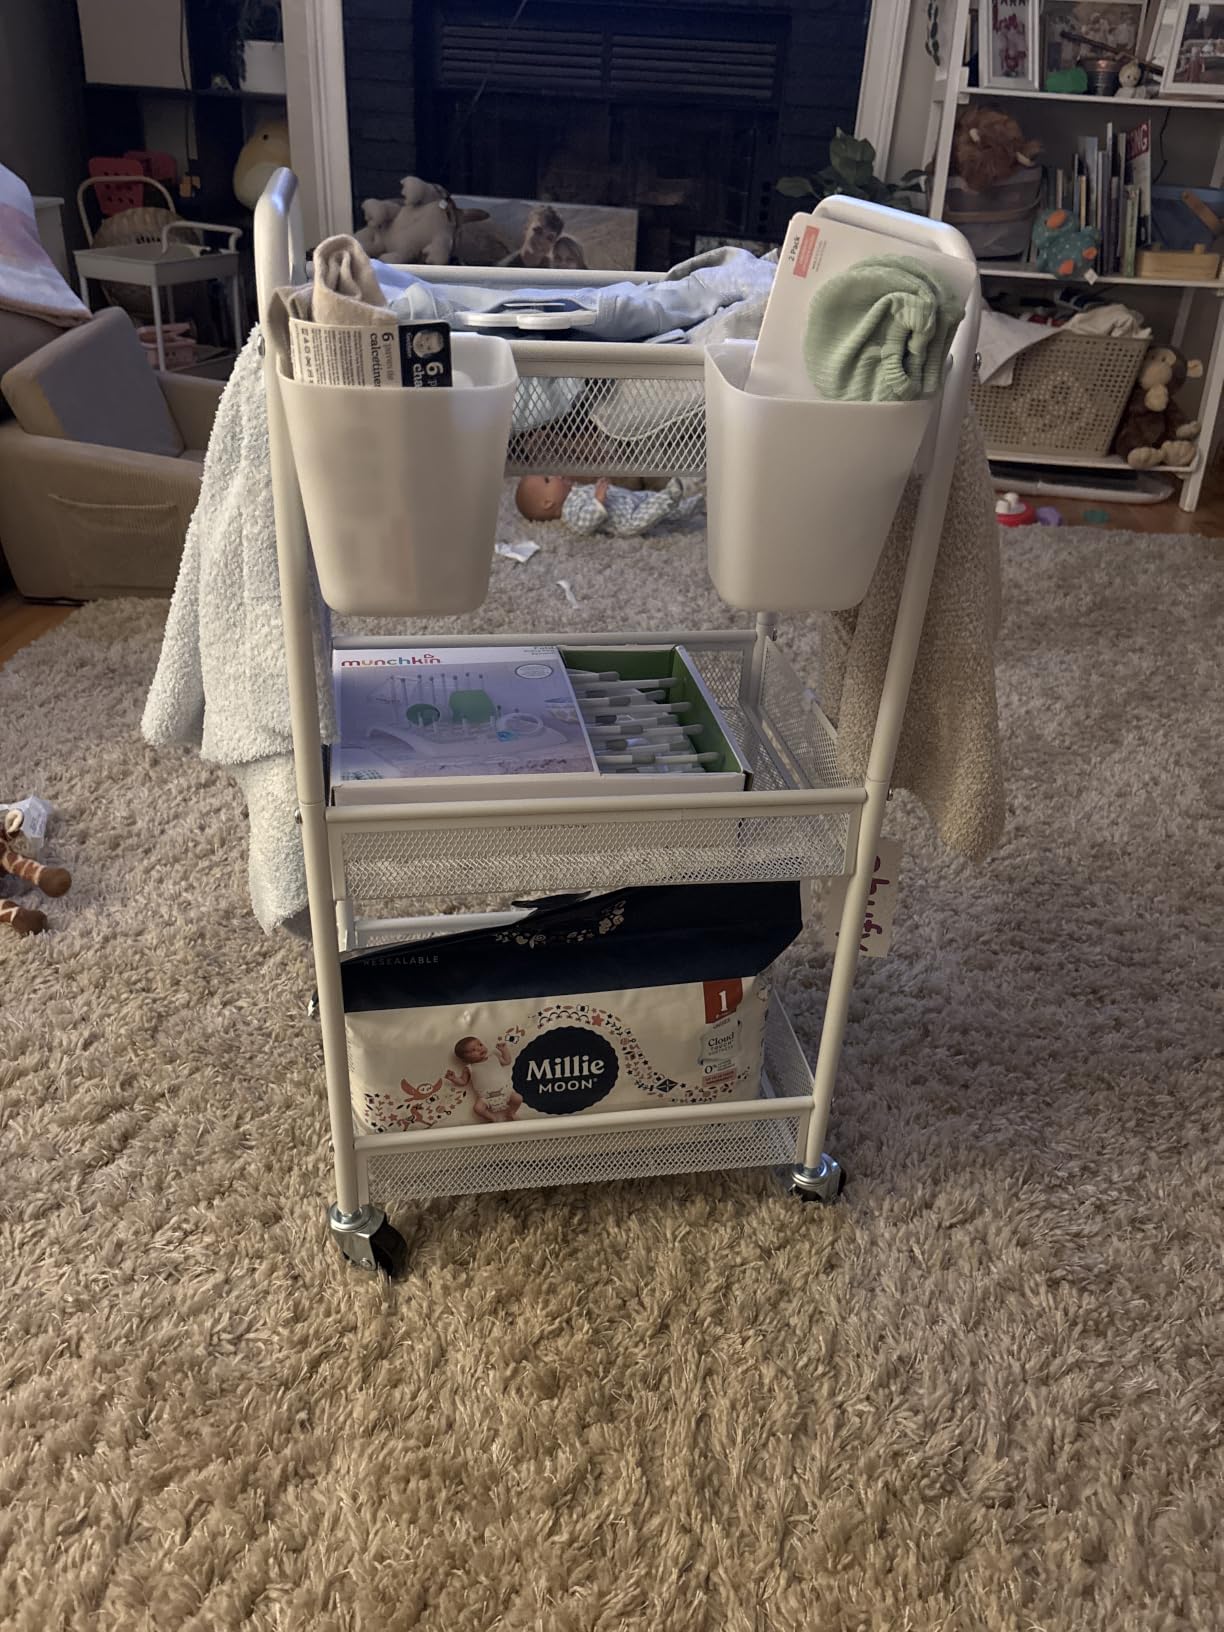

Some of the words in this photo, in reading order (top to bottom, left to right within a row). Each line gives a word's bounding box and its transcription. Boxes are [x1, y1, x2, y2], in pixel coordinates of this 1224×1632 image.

[790, 236, 801, 255] Pack
[381, 332, 394, 342] 6
[425, 361, 444, 376] 6
[341, 654, 441, 667] munchkin
[719, 990, 729, 1012] 1
[708, 1031, 735, 1047] Cloud
[526, 1055, 605, 1081] Millie
[538, 1079, 593, 1094] MOON
